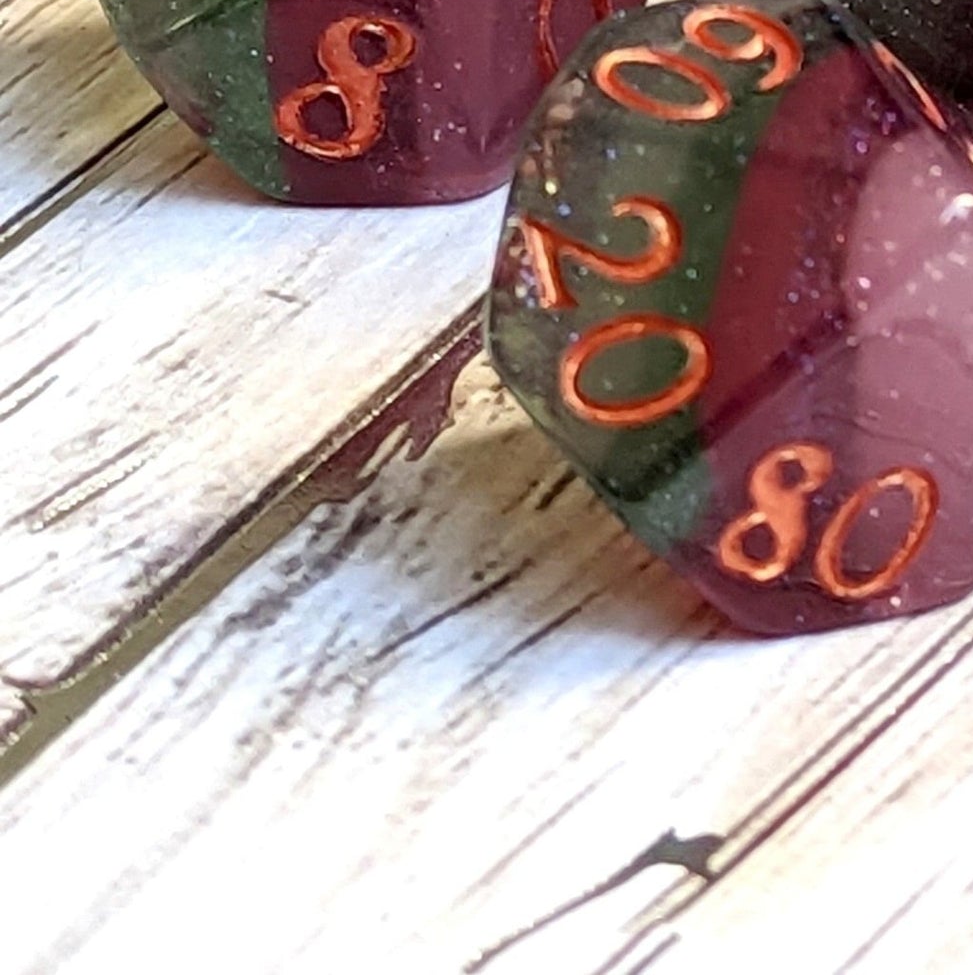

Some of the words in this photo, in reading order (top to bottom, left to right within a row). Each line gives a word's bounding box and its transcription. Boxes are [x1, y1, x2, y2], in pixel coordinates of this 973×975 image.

[273, 12, 420, 163] 8
[508, 193, 718, 429] 20
[715, 441, 939, 601] 80
